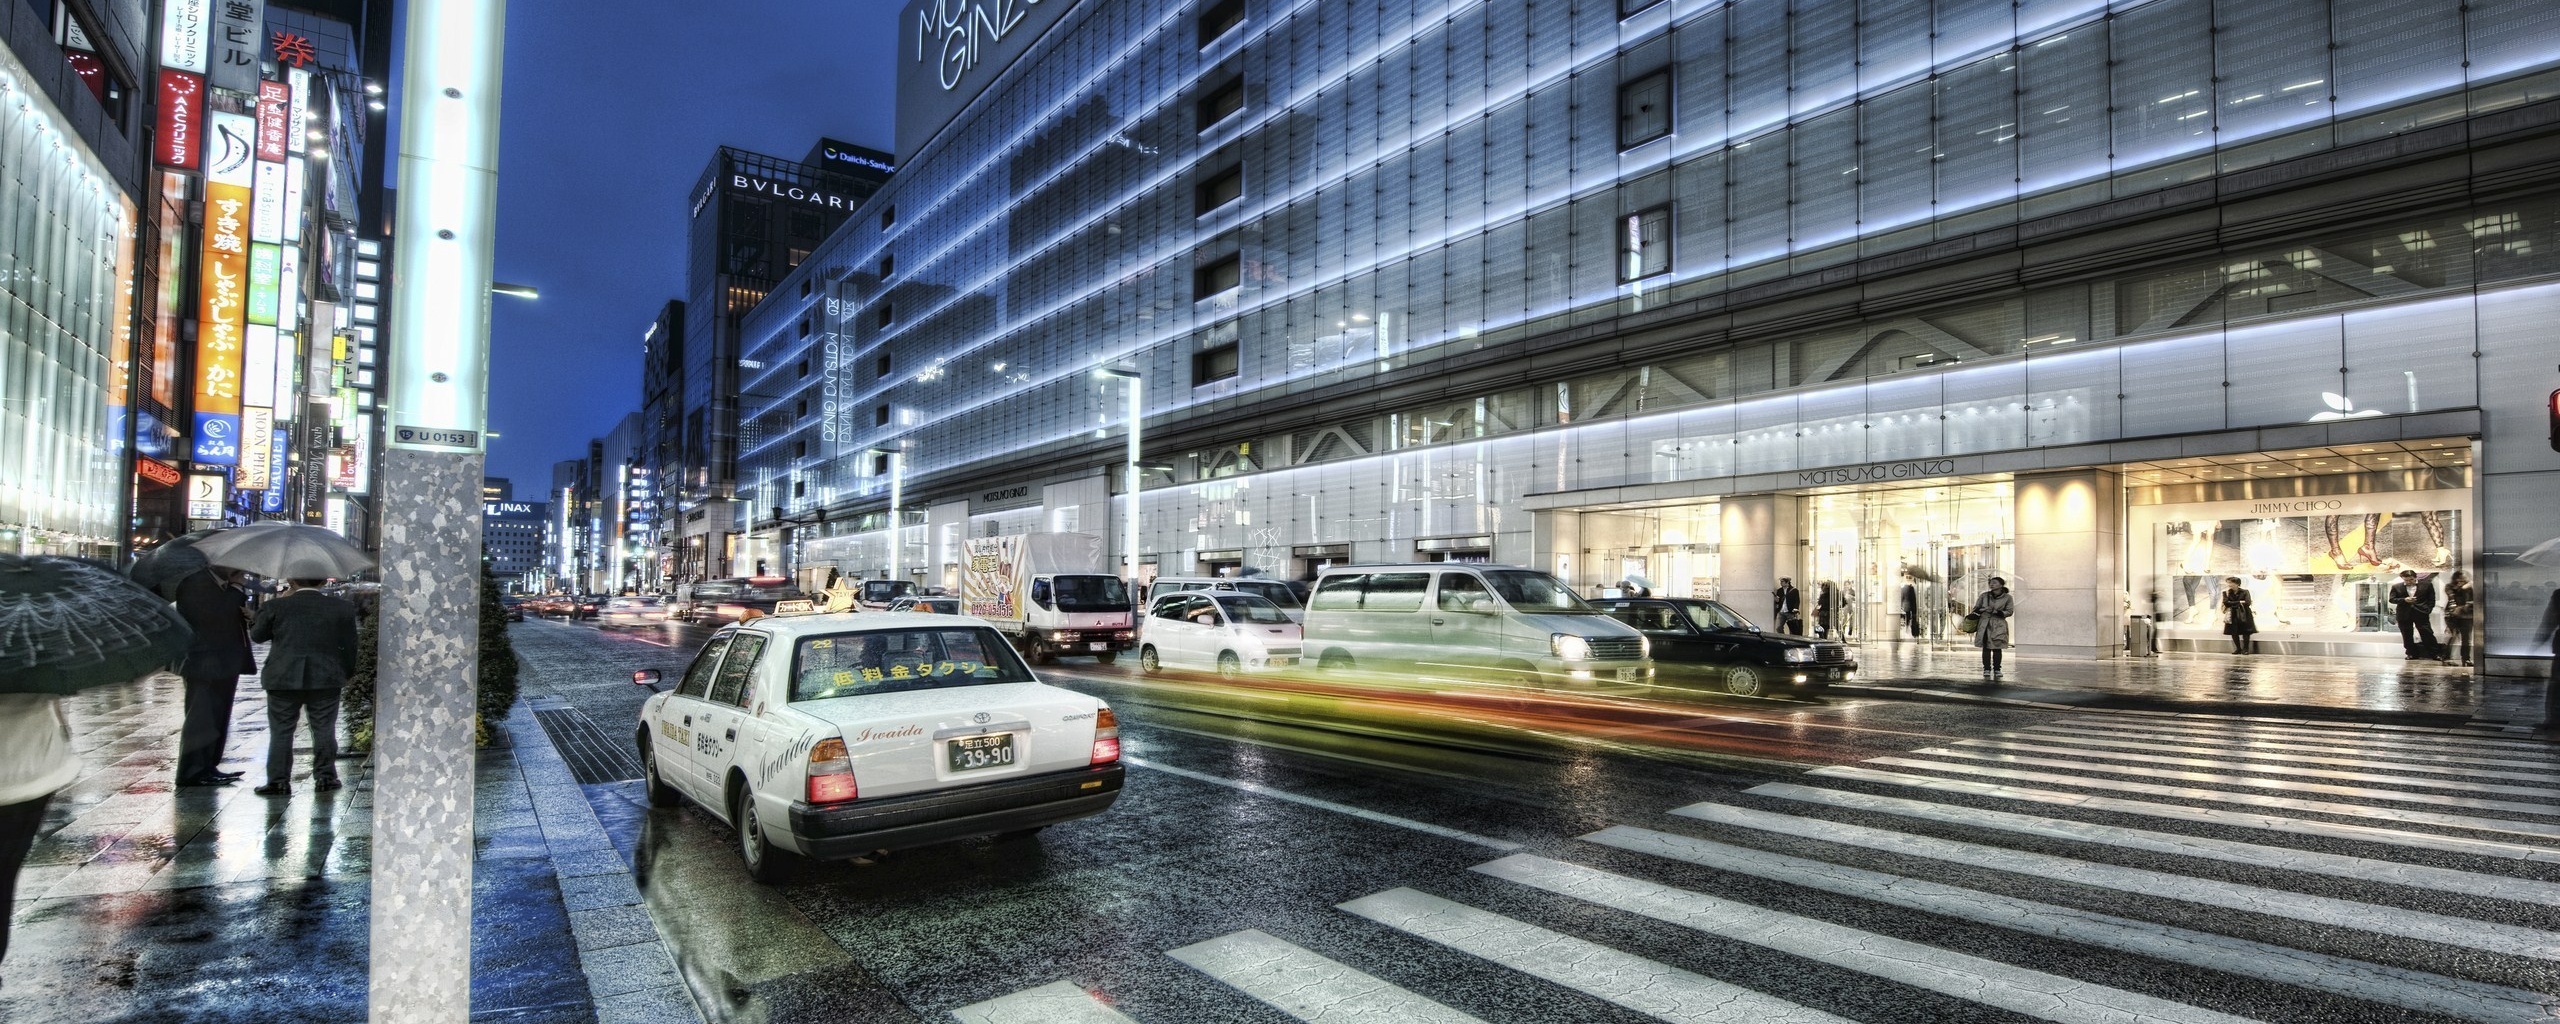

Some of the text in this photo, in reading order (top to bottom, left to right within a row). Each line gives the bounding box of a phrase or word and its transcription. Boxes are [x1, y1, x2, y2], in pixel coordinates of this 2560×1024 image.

[272, 30, 315, 68] 券
[171, 96, 188, 165] AACクリニック
[693, 176, 717, 219] BVLGARI
[733, 175, 855, 212] BVLGARI
[401, 431, 412, 439] 15
[419, 431, 429, 441] U
[433, 432, 465, 444] 0153
[196, 445, 235, 458] らん月
[252, 411, 267, 488] MOON PHASE
[307, 426, 325, 507] GINZA Matsushima
[500, 502, 531, 513] INAX
[2250, 499, 2342, 514] JIMMY CHOO
[811, 639, 833, 650] 22
[832, 661, 1000, 687] 低料金タクシー
[856, 723, 924, 742] Iwaida
[964, 736, 1000, 750] 足立500
[757, 727, 815, 791] Iwaida
[964, 746, 1012, 768] 39-90
